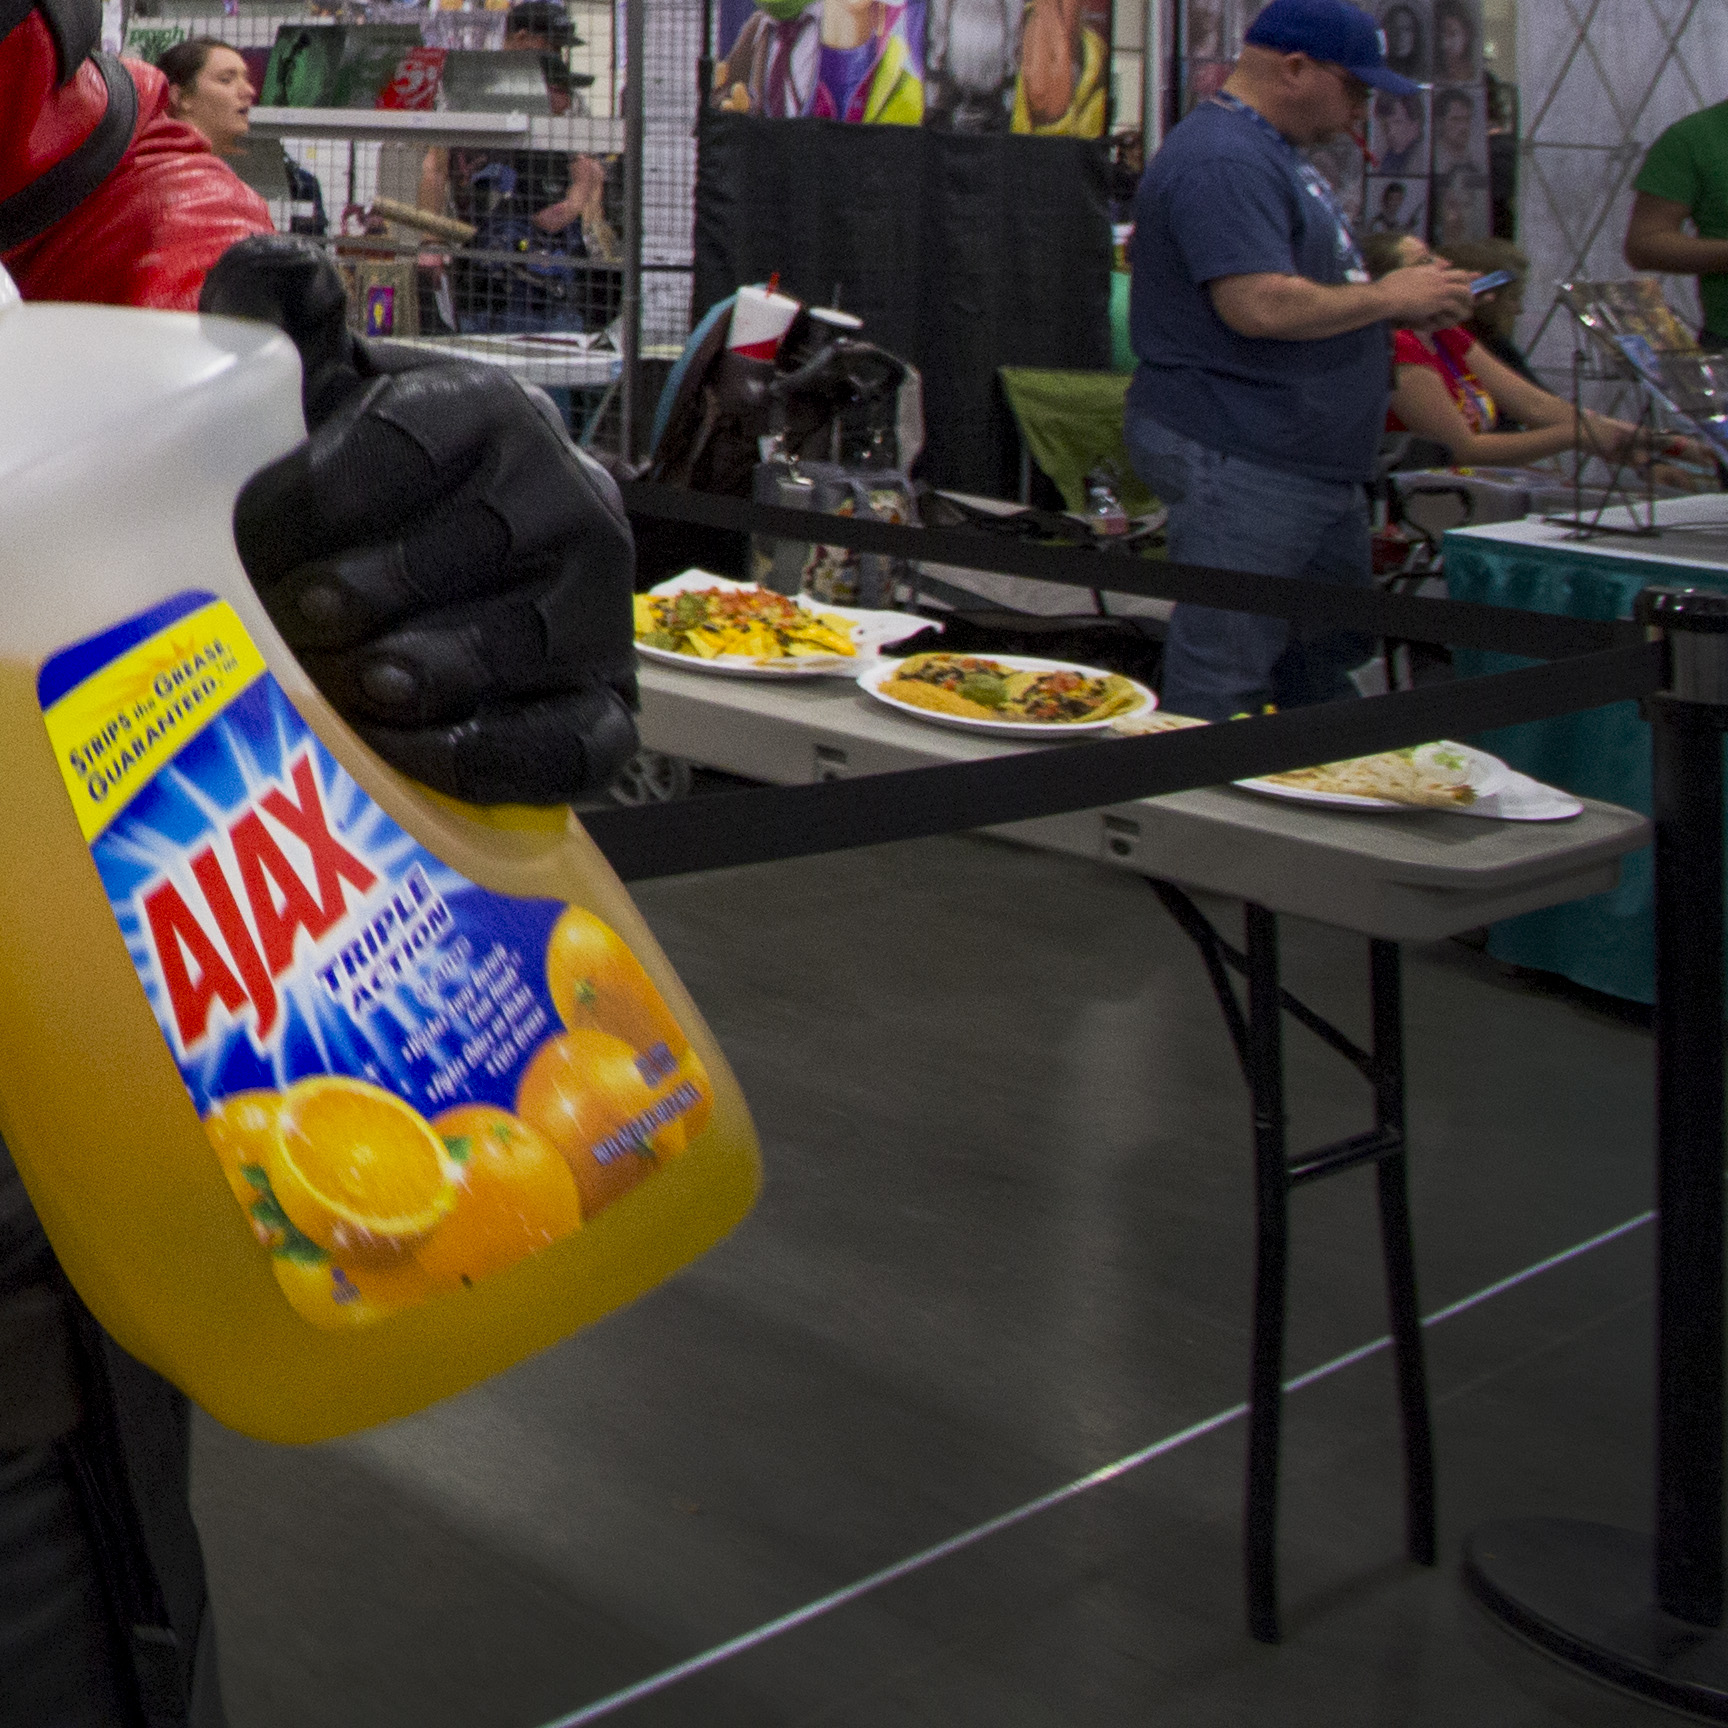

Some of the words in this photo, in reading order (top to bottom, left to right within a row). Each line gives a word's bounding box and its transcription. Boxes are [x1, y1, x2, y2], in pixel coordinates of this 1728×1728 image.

[69, 710, 133, 780] STRIPS
[133, 696, 156, 722] the
[142, 747, 380, 1052] AJAX
[316, 862, 438, 1000] TRIPLE
[351, 899, 454, 1020] ACTION
